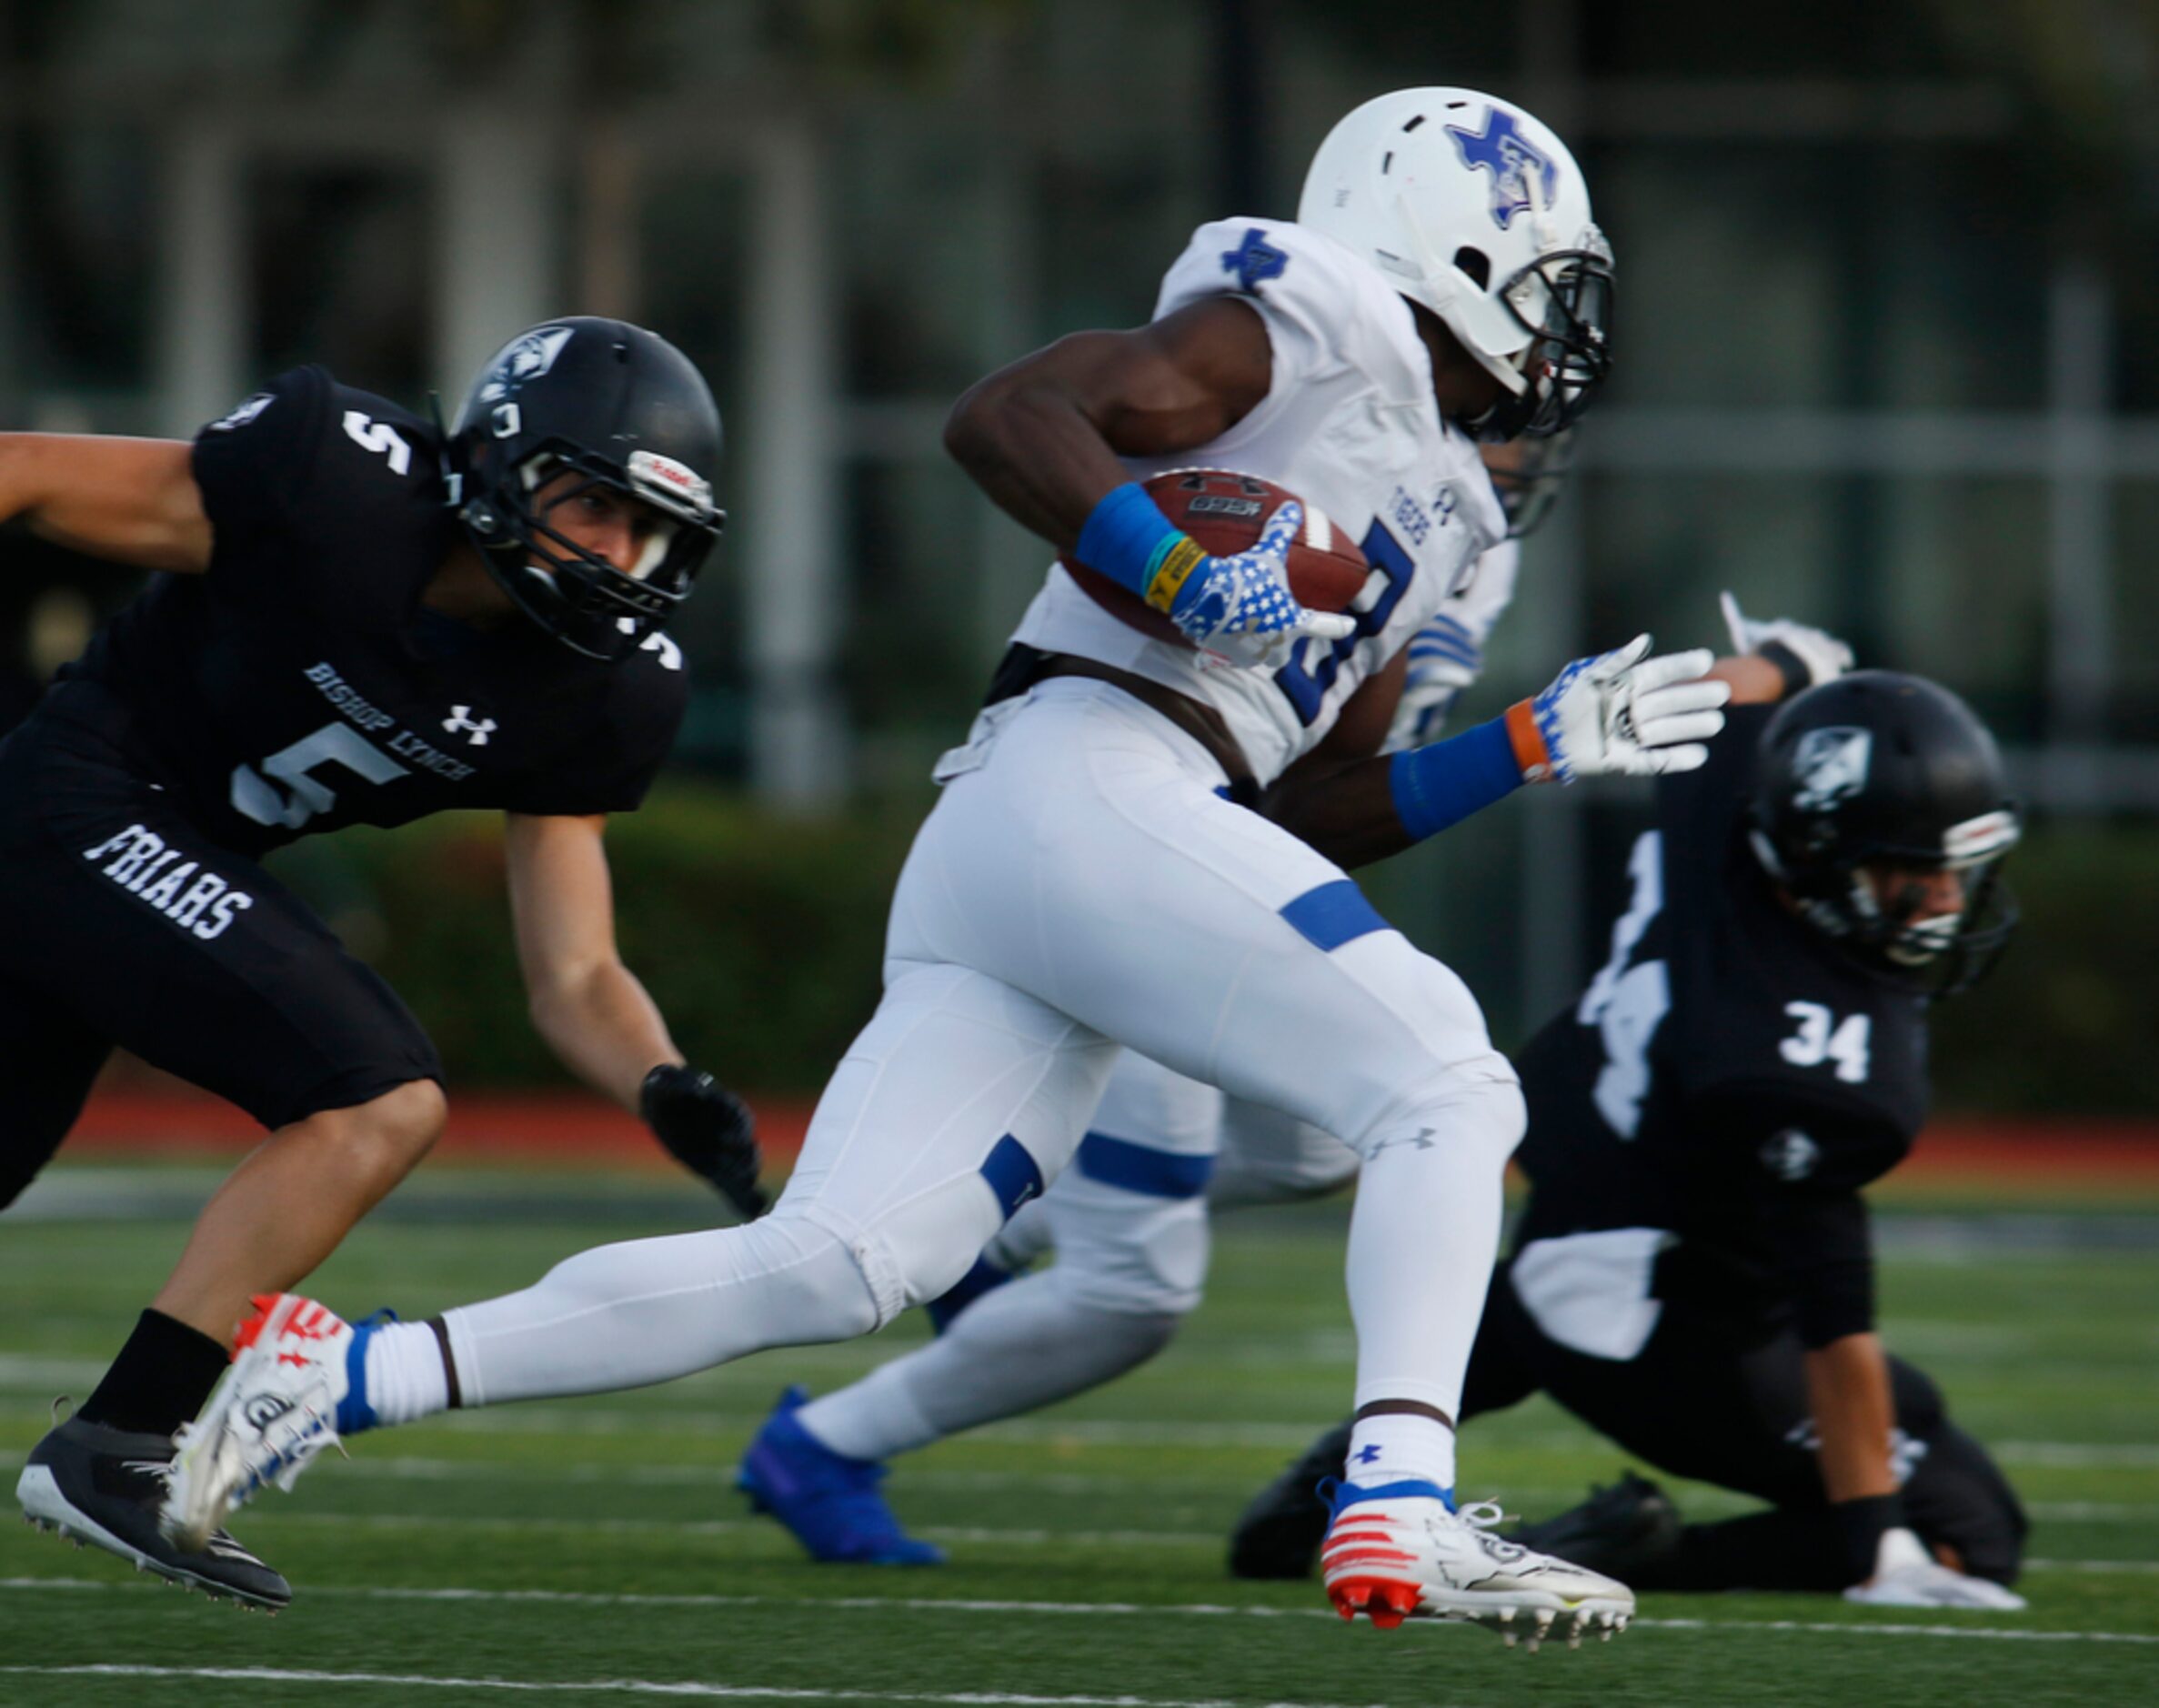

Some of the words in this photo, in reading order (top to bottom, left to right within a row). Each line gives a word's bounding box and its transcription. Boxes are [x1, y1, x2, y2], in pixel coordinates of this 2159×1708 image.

[342, 409, 411, 475] 5
[230, 720, 412, 830] 5
[303, 661, 397, 731] BISHOP
[386, 730, 478, 781] LYNCH
[82, 823, 255, 940] FRIARS
[1778, 1000, 1872, 1083] 34
